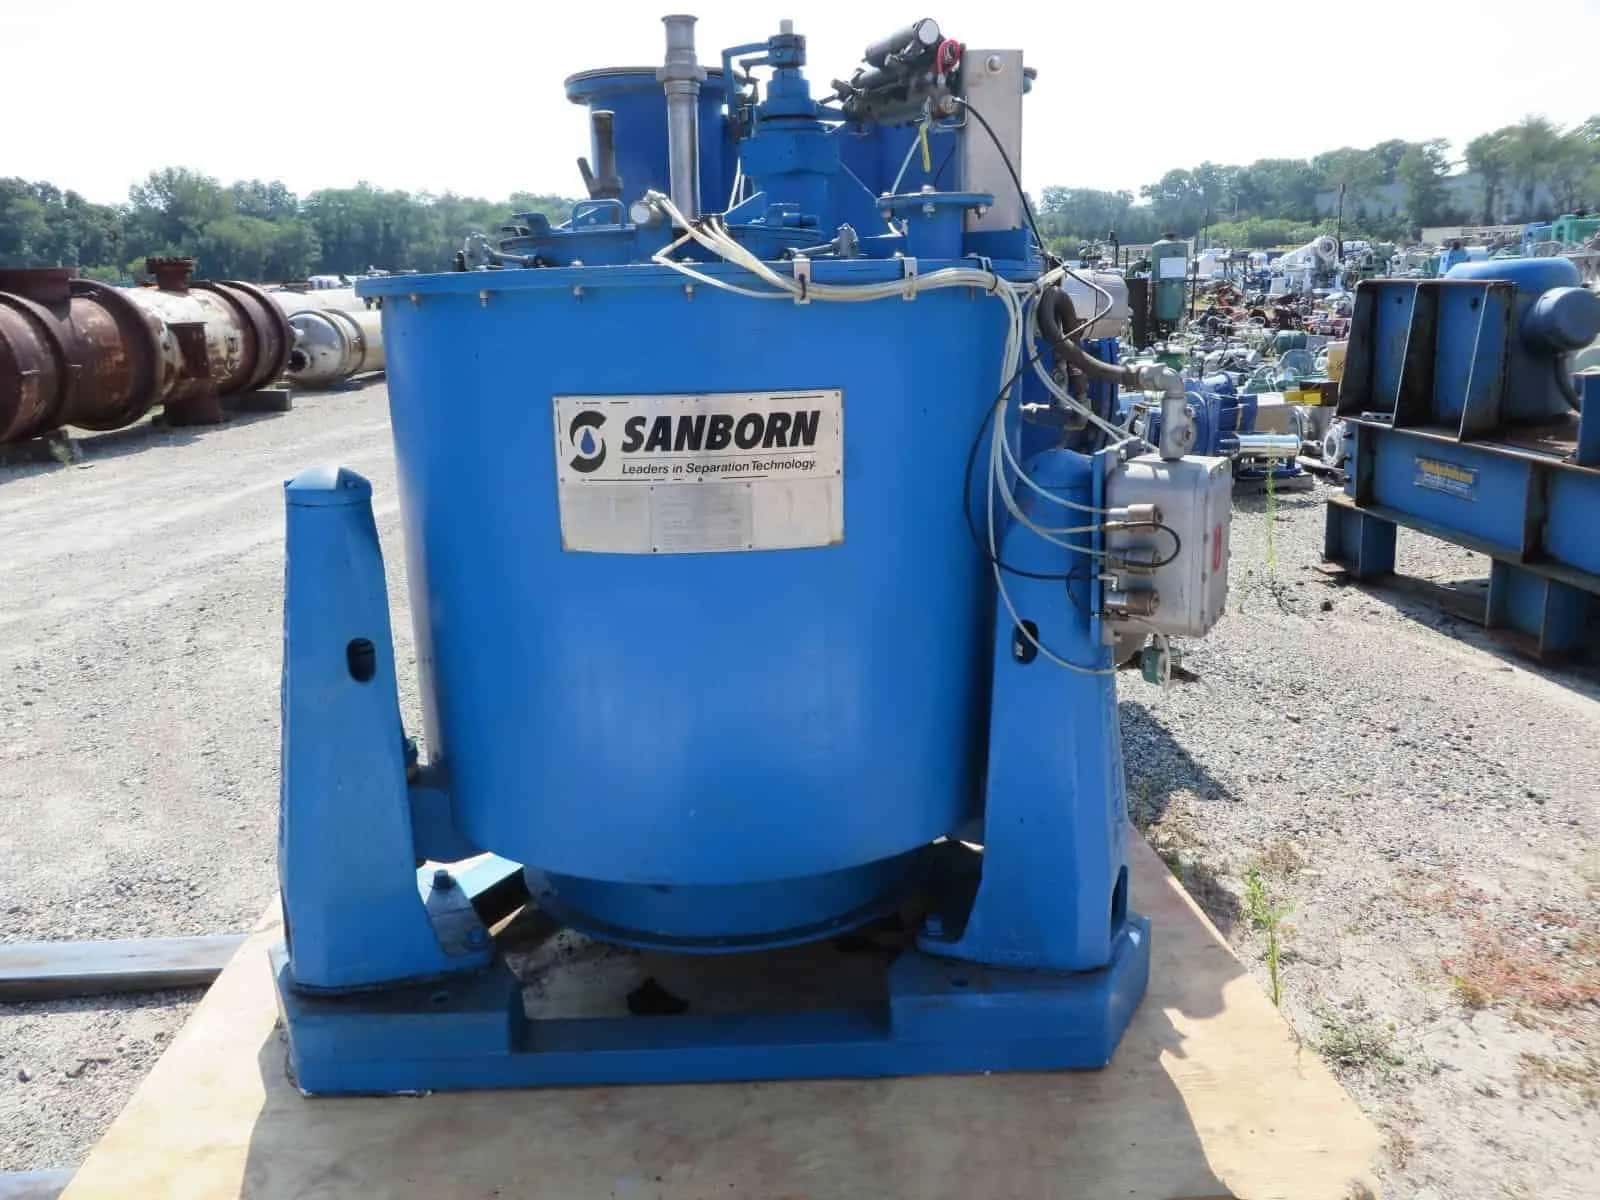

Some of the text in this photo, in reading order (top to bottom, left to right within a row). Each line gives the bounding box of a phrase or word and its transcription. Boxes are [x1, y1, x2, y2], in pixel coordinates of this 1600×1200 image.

[621, 410, 820, 452] SANBORN
[622, 463, 669, 474] Leaders
[672, 464, 683, 473] in
[685, 461, 749, 475] Separation
